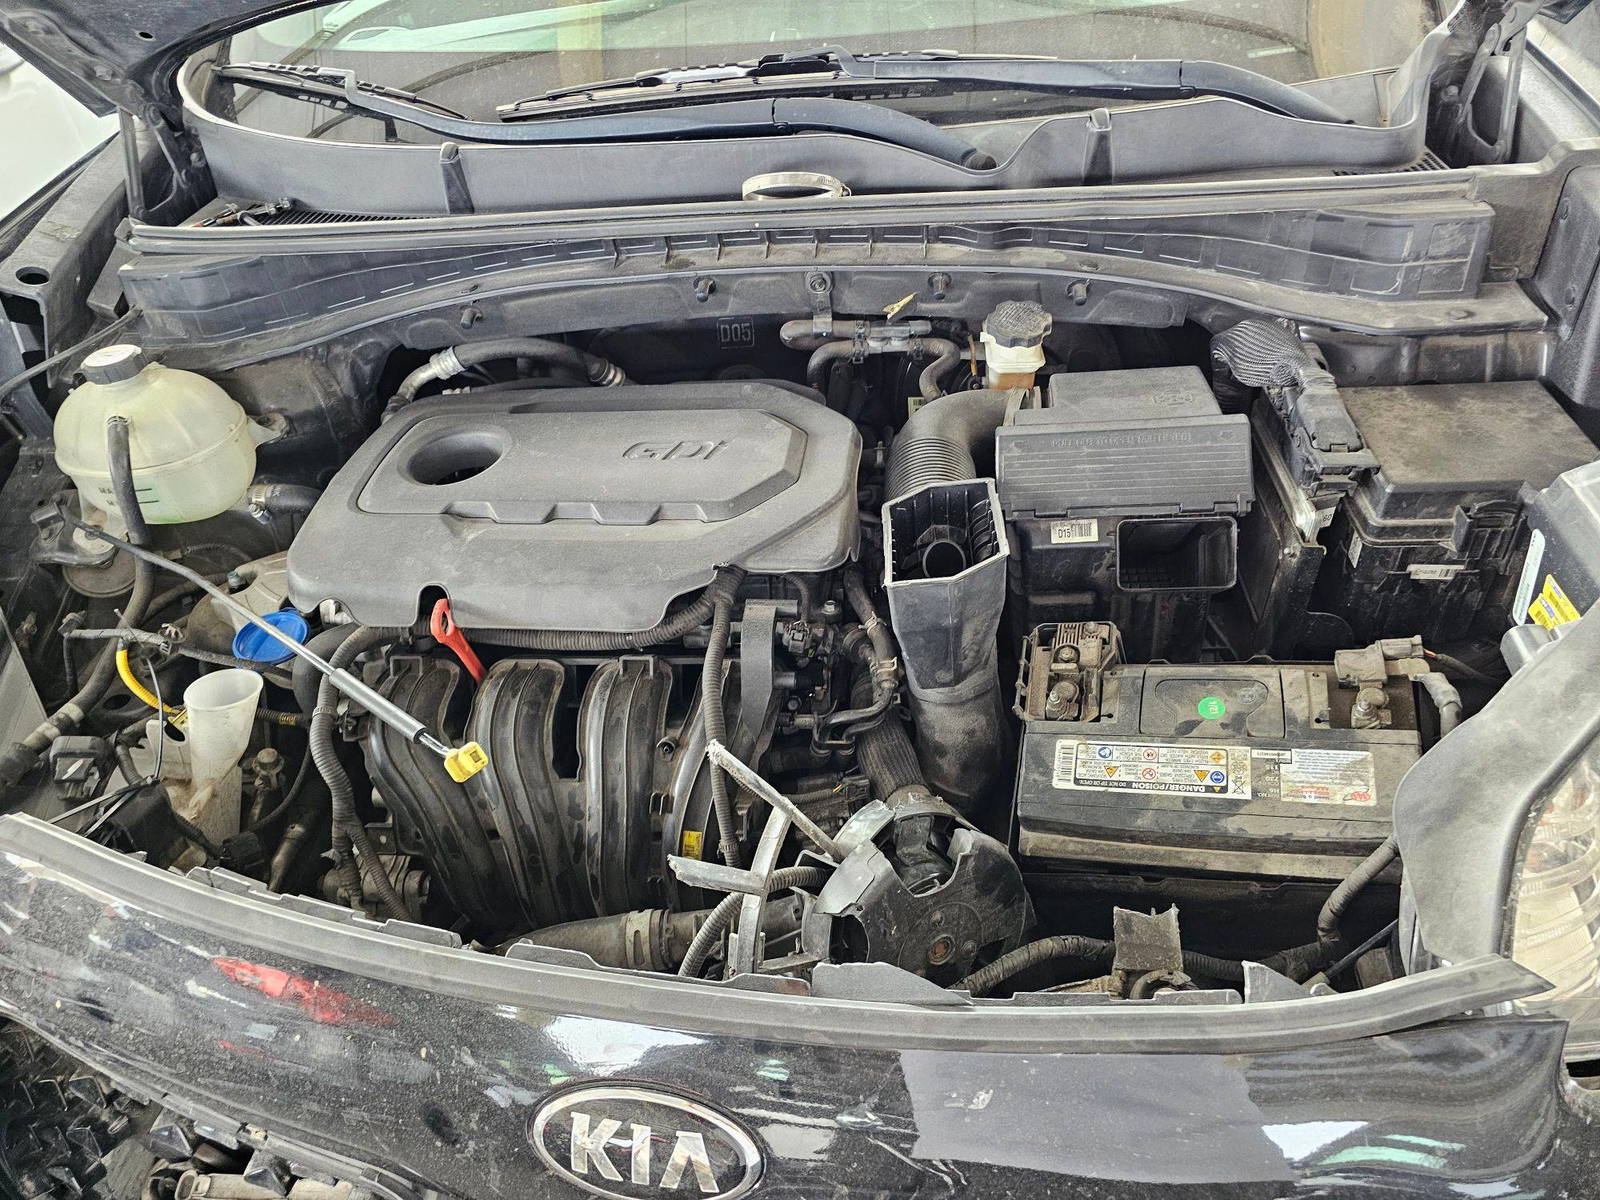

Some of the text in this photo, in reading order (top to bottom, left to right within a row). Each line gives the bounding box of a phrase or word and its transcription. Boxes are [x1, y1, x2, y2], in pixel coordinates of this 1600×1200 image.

[720, 322, 752, 343] D05
[1057, 528, 1072, 539] D15
[1132, 782, 1206, 793] DANGER/POISON
[570, 1111, 720, 1194] KIA
